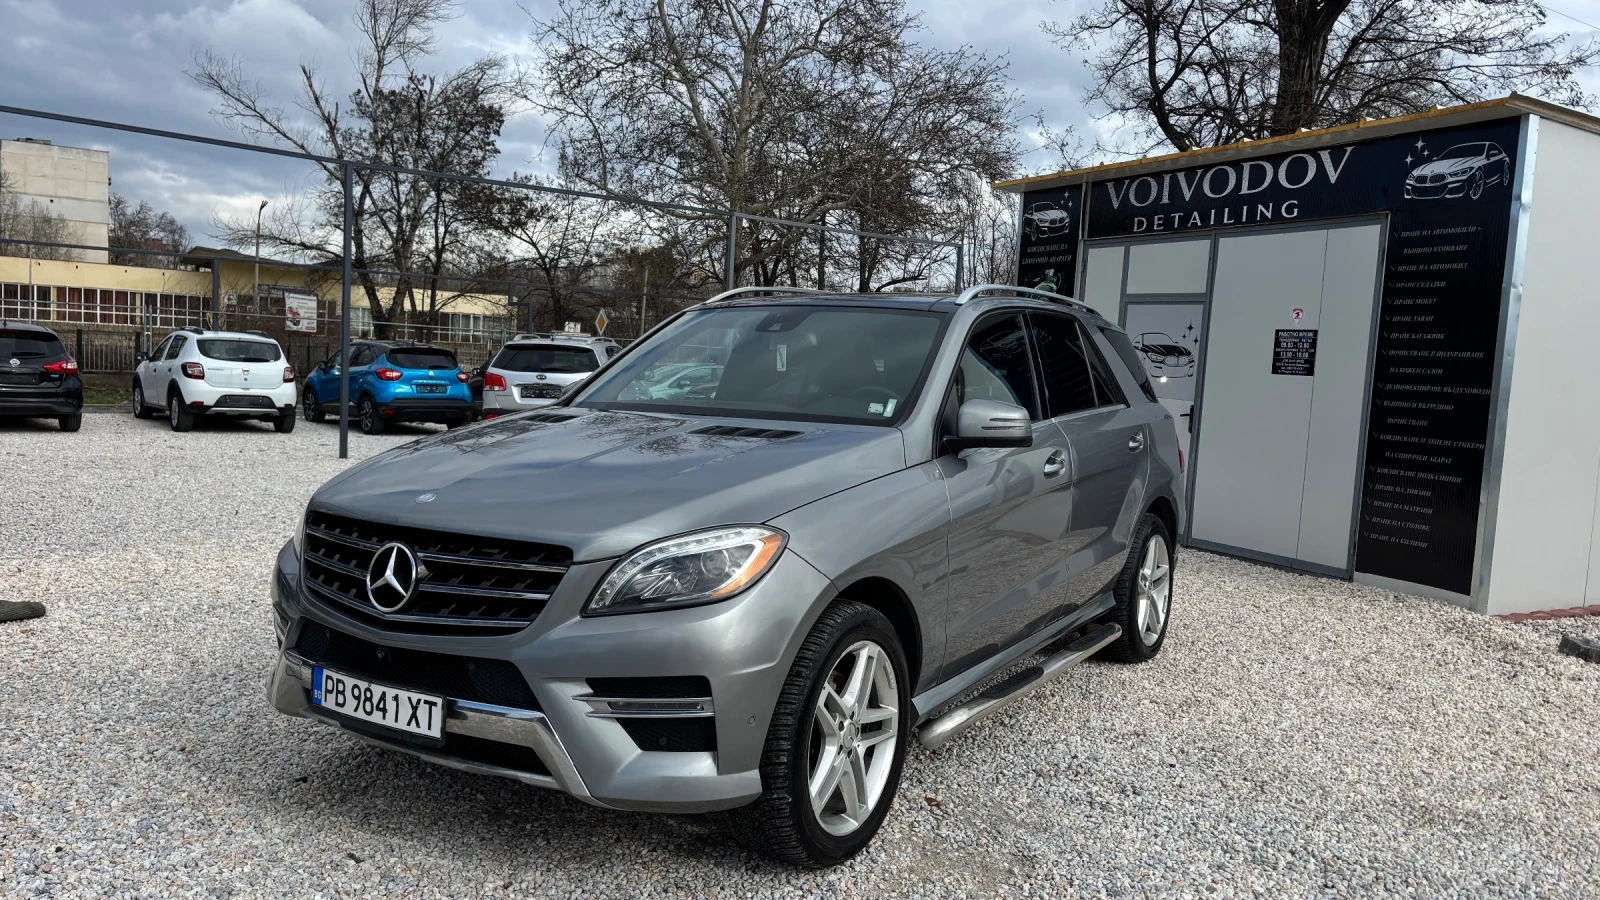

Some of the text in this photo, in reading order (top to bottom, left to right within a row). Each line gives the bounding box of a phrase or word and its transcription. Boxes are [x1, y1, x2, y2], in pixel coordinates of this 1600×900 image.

[1105, 145, 1356, 210] VOIVODOV
[1133, 200, 1299, 233] DETAILING
[1400, 230, 1421, 238] ПРАНЕ
[1431, 226, 1477, 236] АВТОМОБИЛИ
[1397, 262, 1468, 272] ПРАНЕ НА АВТОМОБИЛ
[1417, 280, 1446, 288] СЕДАЛКИ
[1383, 400, 1411, 408] ВЪНШНО
[1417, 402, 1455, 411] ВЪТРЕШНО
[1386, 417, 1429, 427] ПОЧИСТВАНЕ
[1453, 441, 1485, 450] СТИКЕРИ
[1394, 452, 1428, 462] СПИРАЧЕН
[1374, 483, 1394, 492] ПРАНЕ
[1404, 488, 1432, 497] ДИВАНИ
[1373, 500, 1393, 508] ПРАНЕ
[1403, 504, 1433, 515] МАТРАЦИ
[1371, 516, 1391, 525] ПРАНЕ
[1401, 522, 1431, 532] СТОЛОВЕ
[1370, 533, 1390, 542] ПРАНЕ
[1399, 539, 1428, 549] КИЛИМИ
[323, 673, 438, 731] PB 9841 XT
